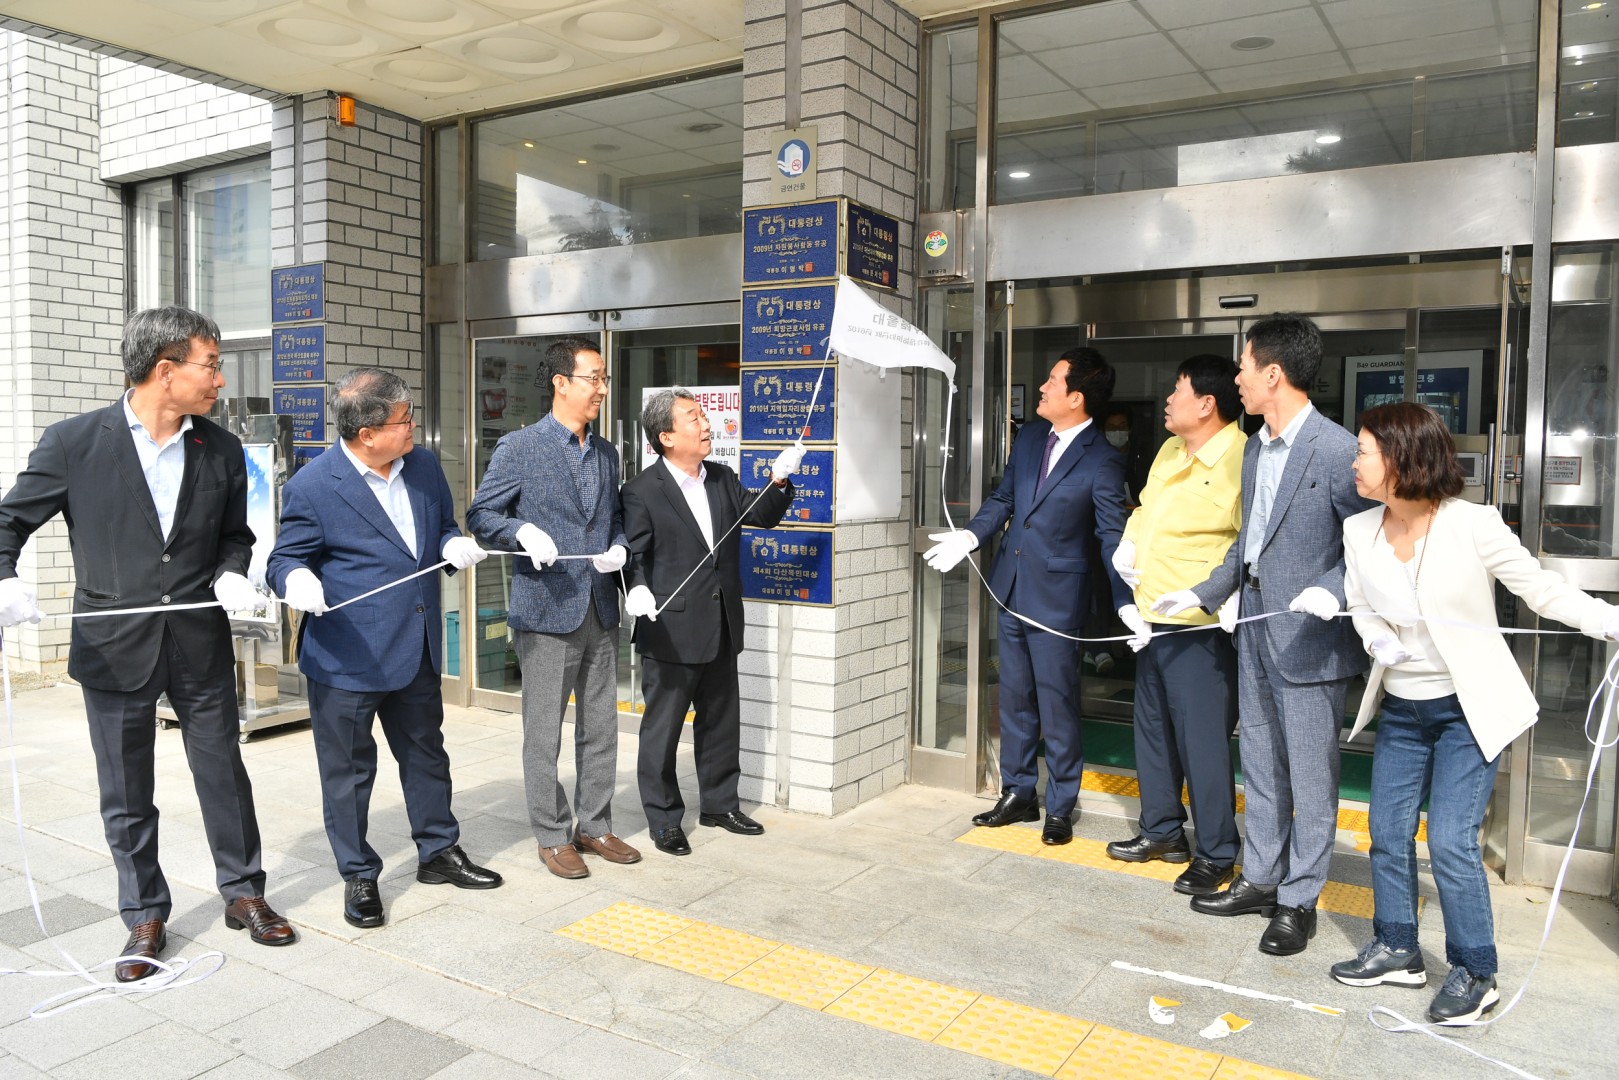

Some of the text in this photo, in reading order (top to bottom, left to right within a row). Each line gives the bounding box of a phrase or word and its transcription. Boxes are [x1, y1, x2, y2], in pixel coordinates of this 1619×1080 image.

[780, 183, 805, 192] 금연건물
[788, 215, 824, 230] 대통령상
[753, 244, 773, 253] 2009년
[786, 299, 822, 311] 대통령상
[752, 323, 826, 334] 2009년 희망근로사업 유공
[749, 404, 769, 413] 2010년
[814, 404, 826, 412] 유공
[813, 489, 825, 499] 우수
[782, 544, 818, 556] 대통령상
[753, 566, 771, 575] 제4회
